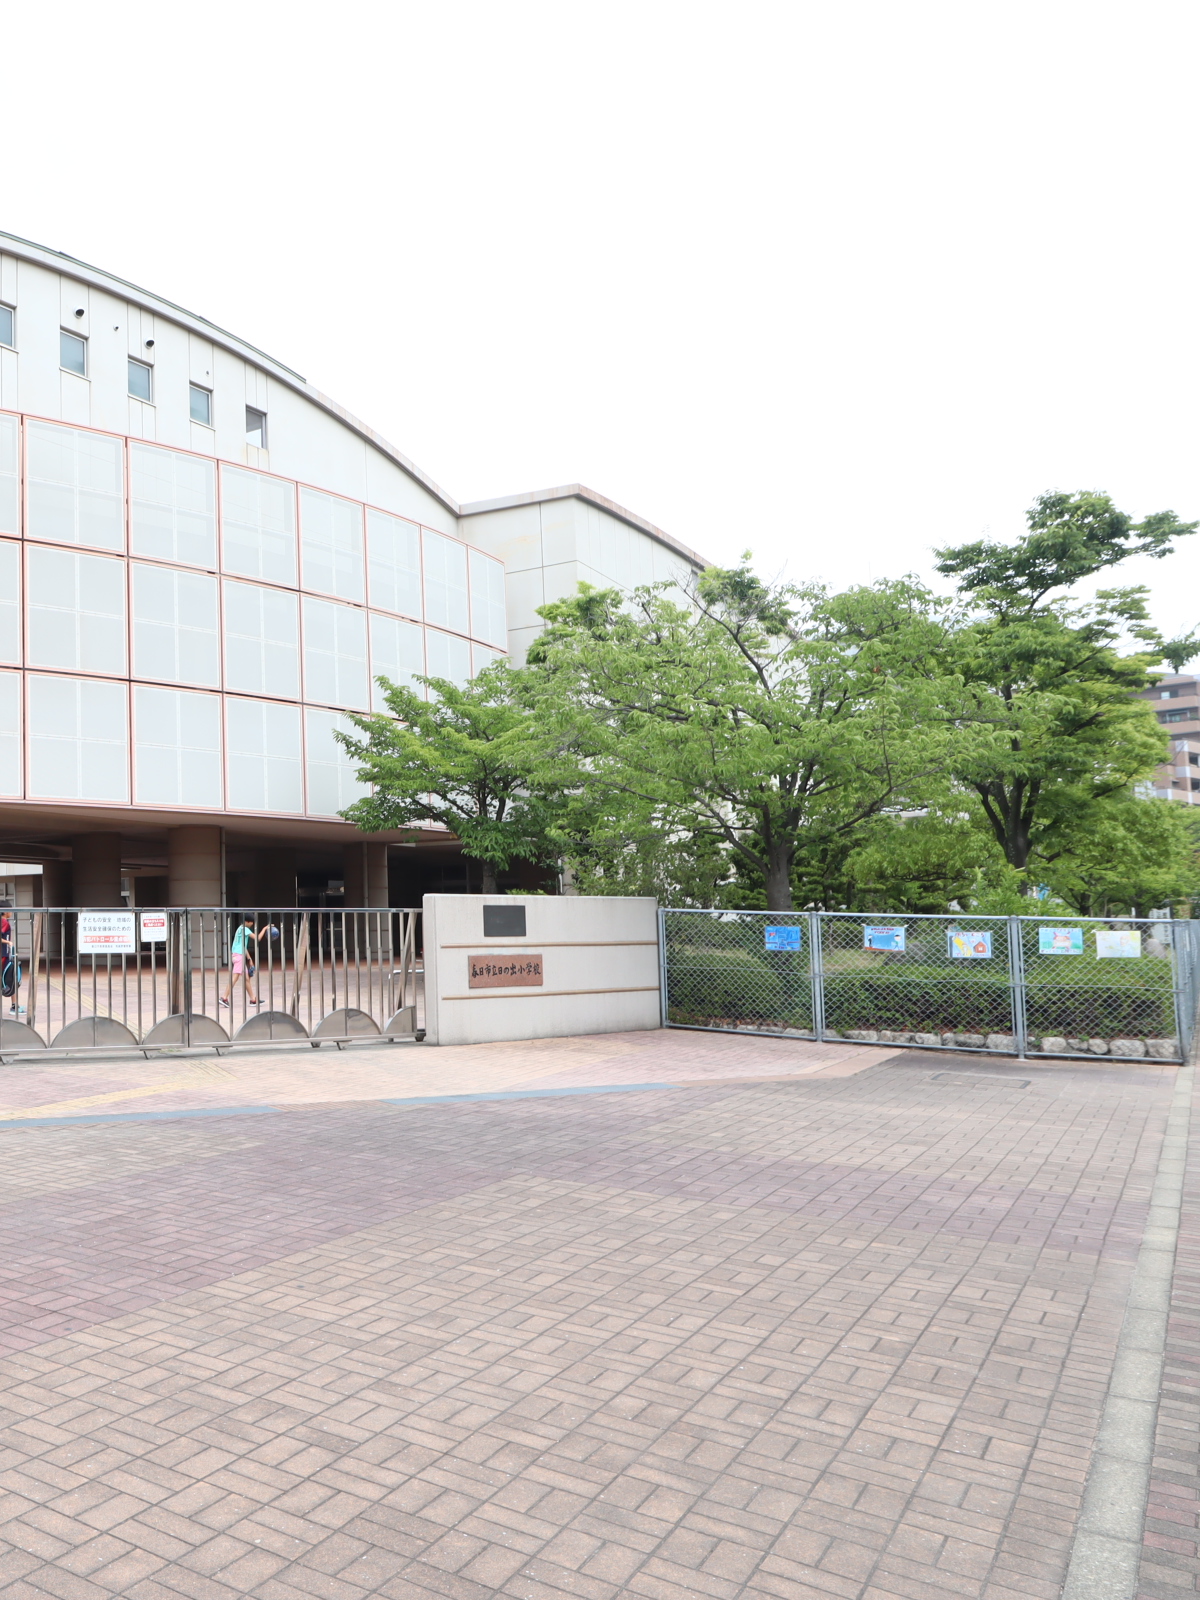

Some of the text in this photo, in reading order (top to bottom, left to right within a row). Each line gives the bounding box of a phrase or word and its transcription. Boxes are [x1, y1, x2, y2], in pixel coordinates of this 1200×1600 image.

[471, 962, 541, 979] 春日市立日の出小学校
